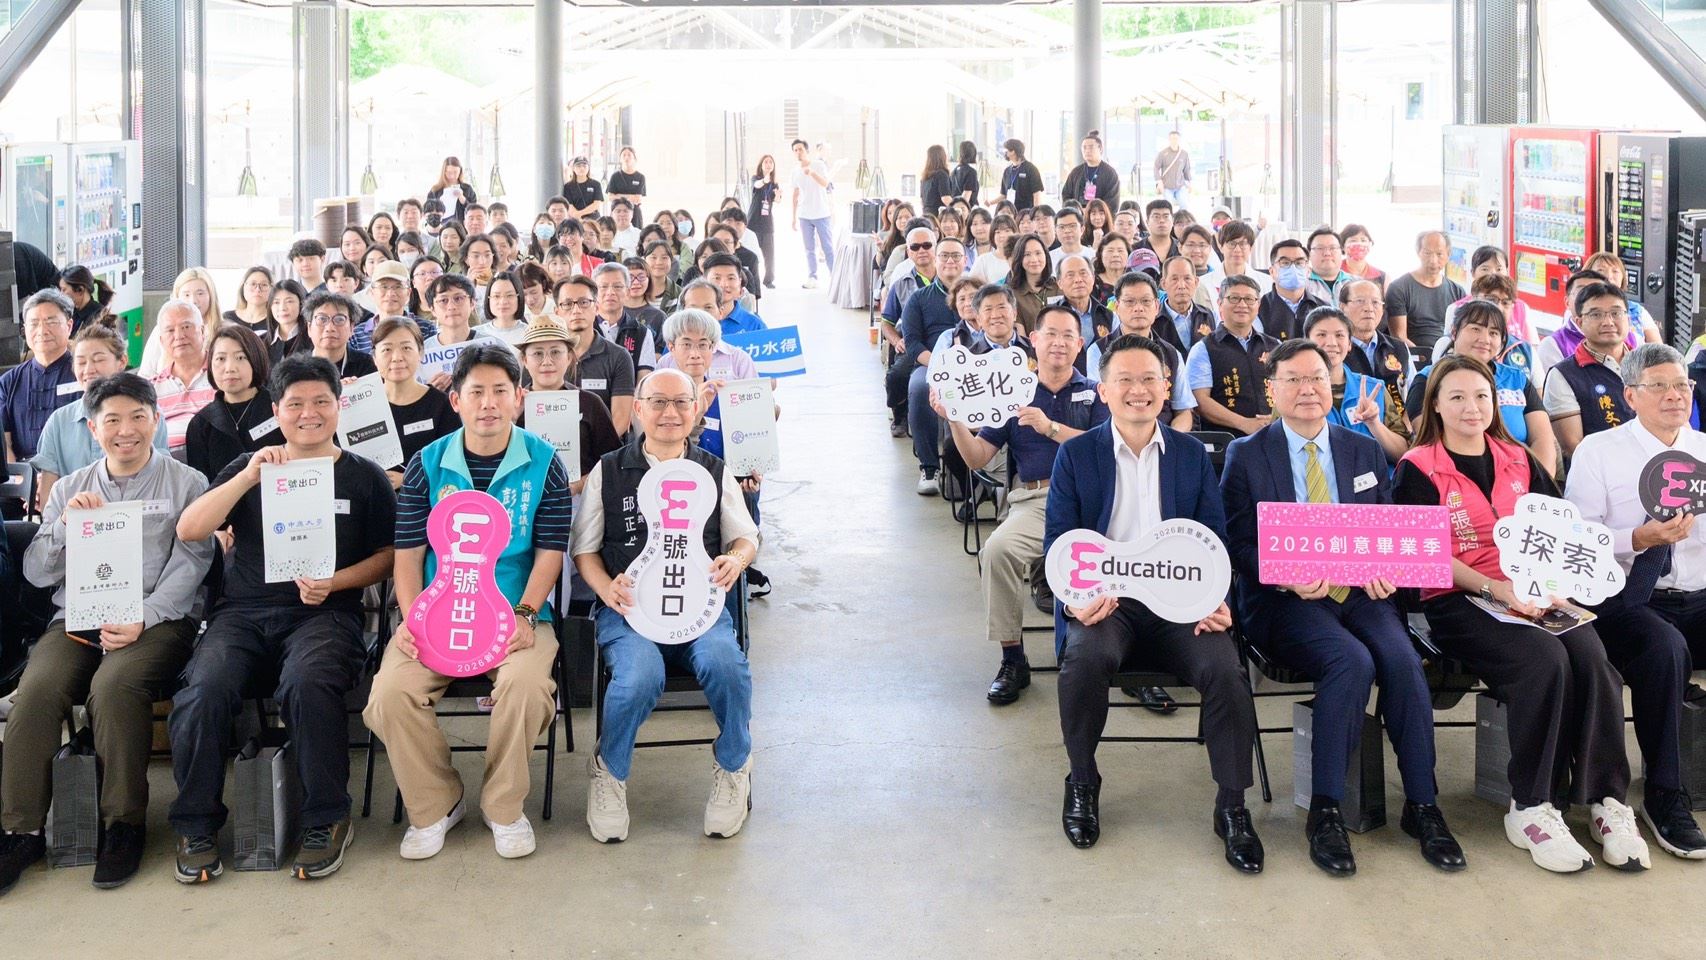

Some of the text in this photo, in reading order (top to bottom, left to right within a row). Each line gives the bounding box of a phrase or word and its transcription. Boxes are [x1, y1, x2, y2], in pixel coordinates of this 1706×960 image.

[954, 371, 1014, 401] 進化
[1598, 394, 1620, 427] 陳文
[518, 480, 533, 537] 桃園市議員
[1154, 525, 1218, 552] 2026創意畢業季
[1269, 535, 1442, 557] 2026創意畢業季
[1519, 525, 1597, 579] 探索
[1069, 542, 1202, 589] Education
[457, 611, 509, 673] 2026創意畢業季
